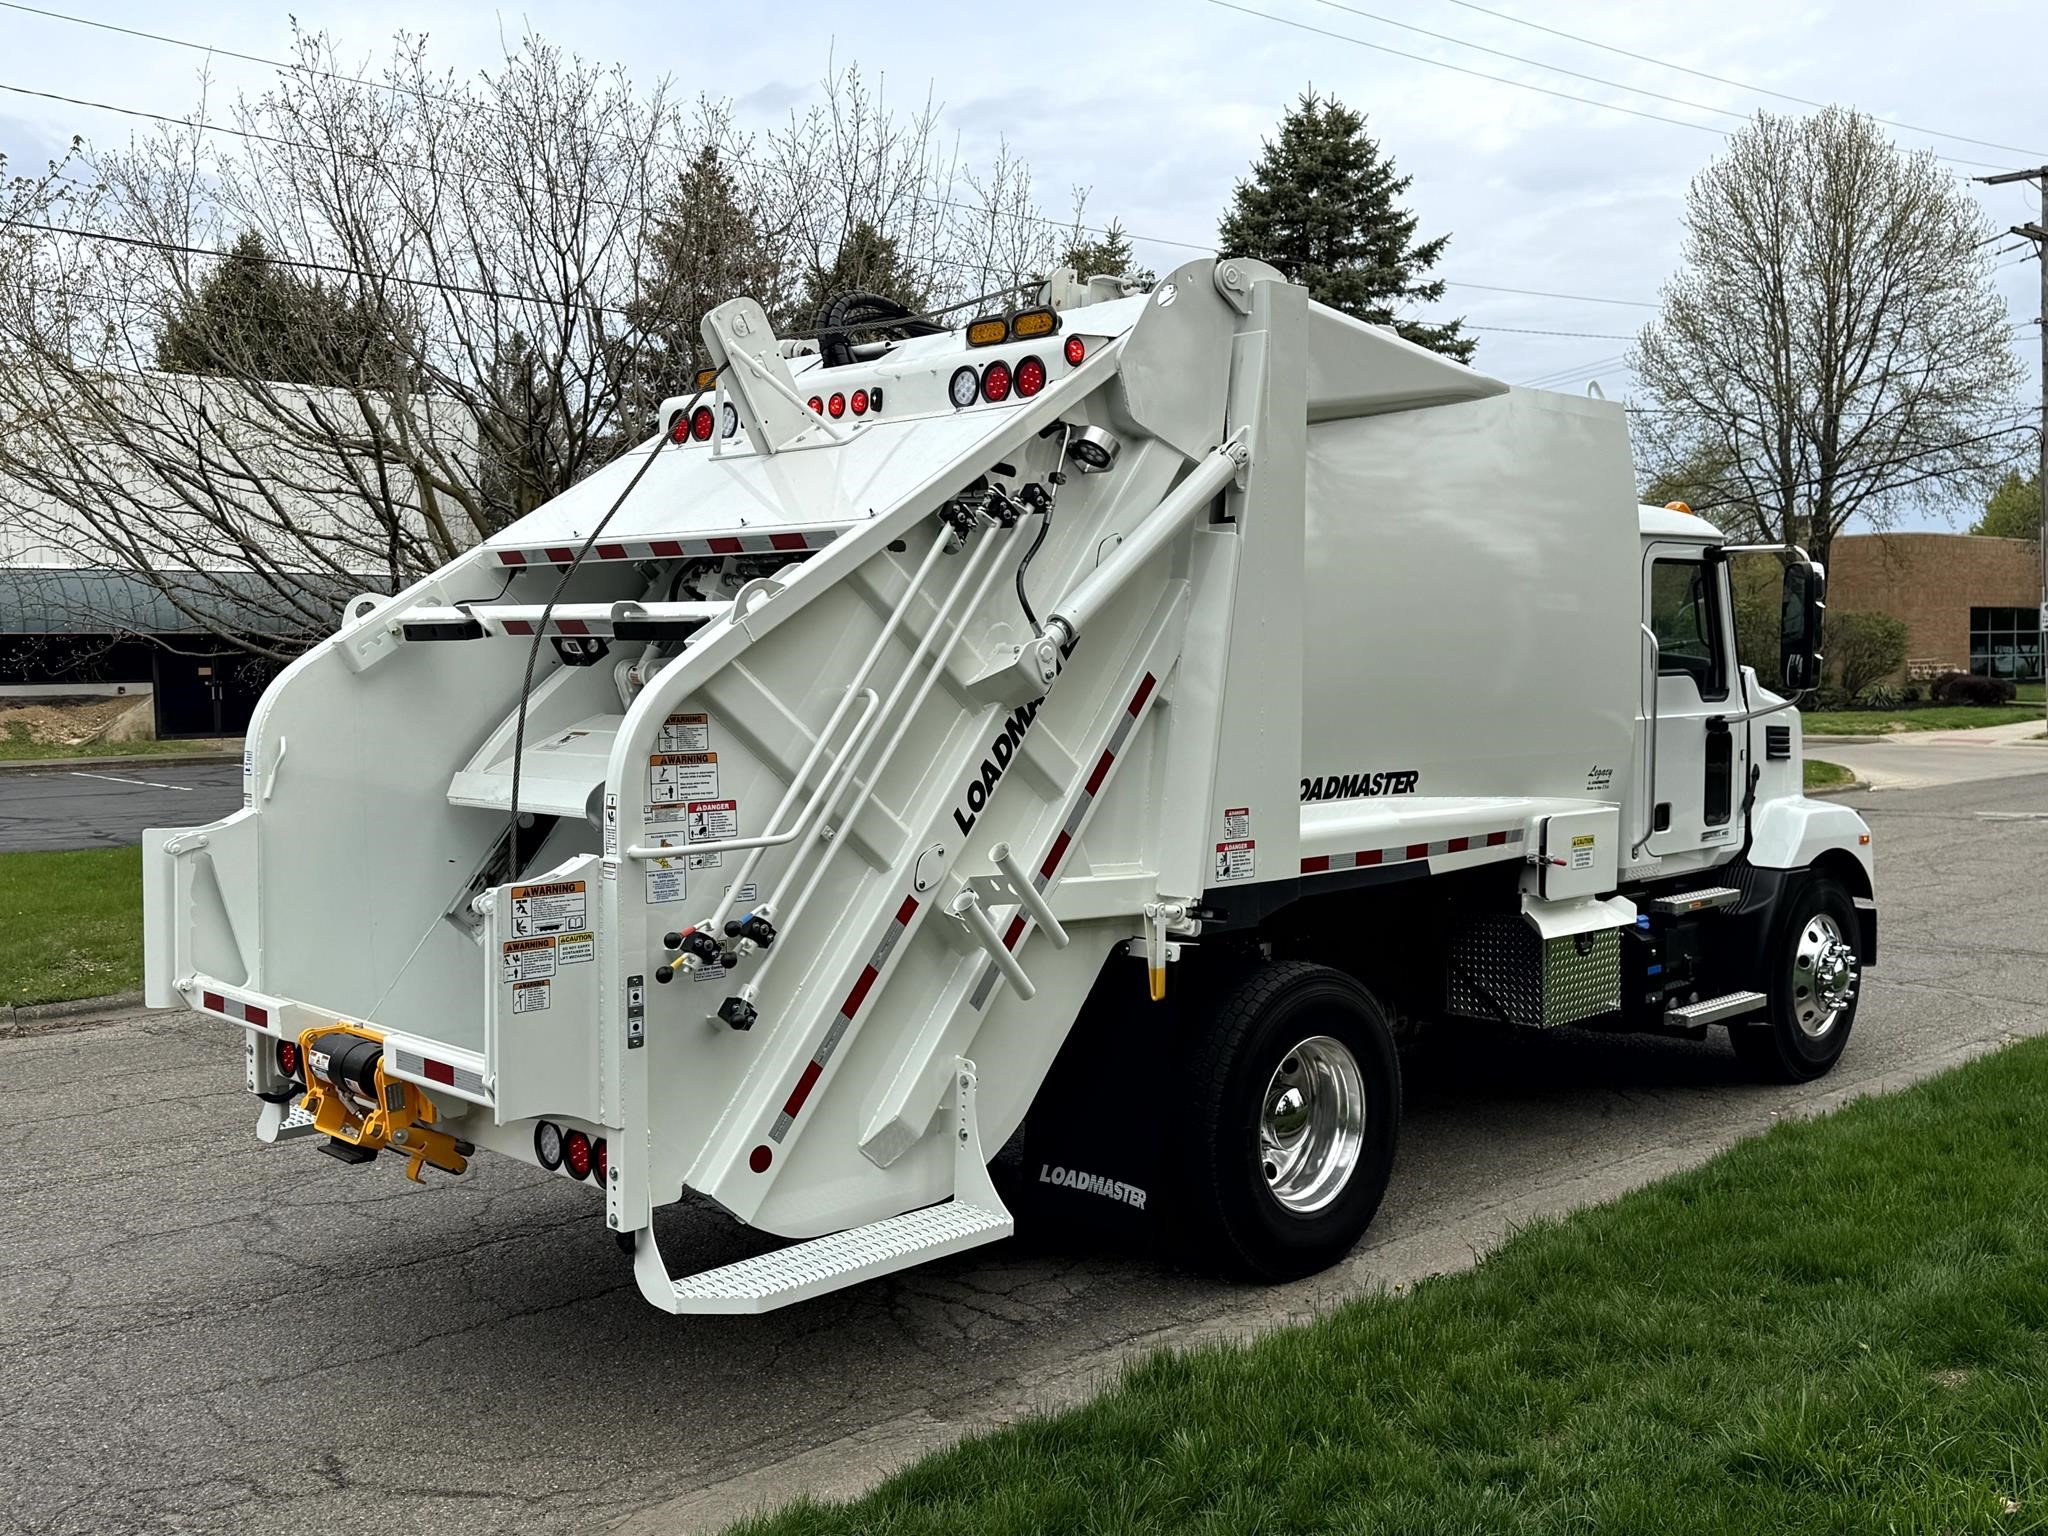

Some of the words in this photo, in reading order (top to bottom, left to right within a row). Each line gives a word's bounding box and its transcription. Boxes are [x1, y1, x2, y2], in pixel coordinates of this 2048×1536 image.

[667, 754, 709, 765] WARNING
[1587, 764, 1613, 780] Legacy
[1300, 770, 1419, 801] OADMASTER
[702, 803, 730, 811] DANGER
[1229, 843, 1248, 851] DANGER
[530, 883, 576, 897] WARNING
[565, 934, 592, 943] CAUTION
[512, 940, 549, 950] WARNING
[1040, 1164, 1147, 1210] LOADMASTER
